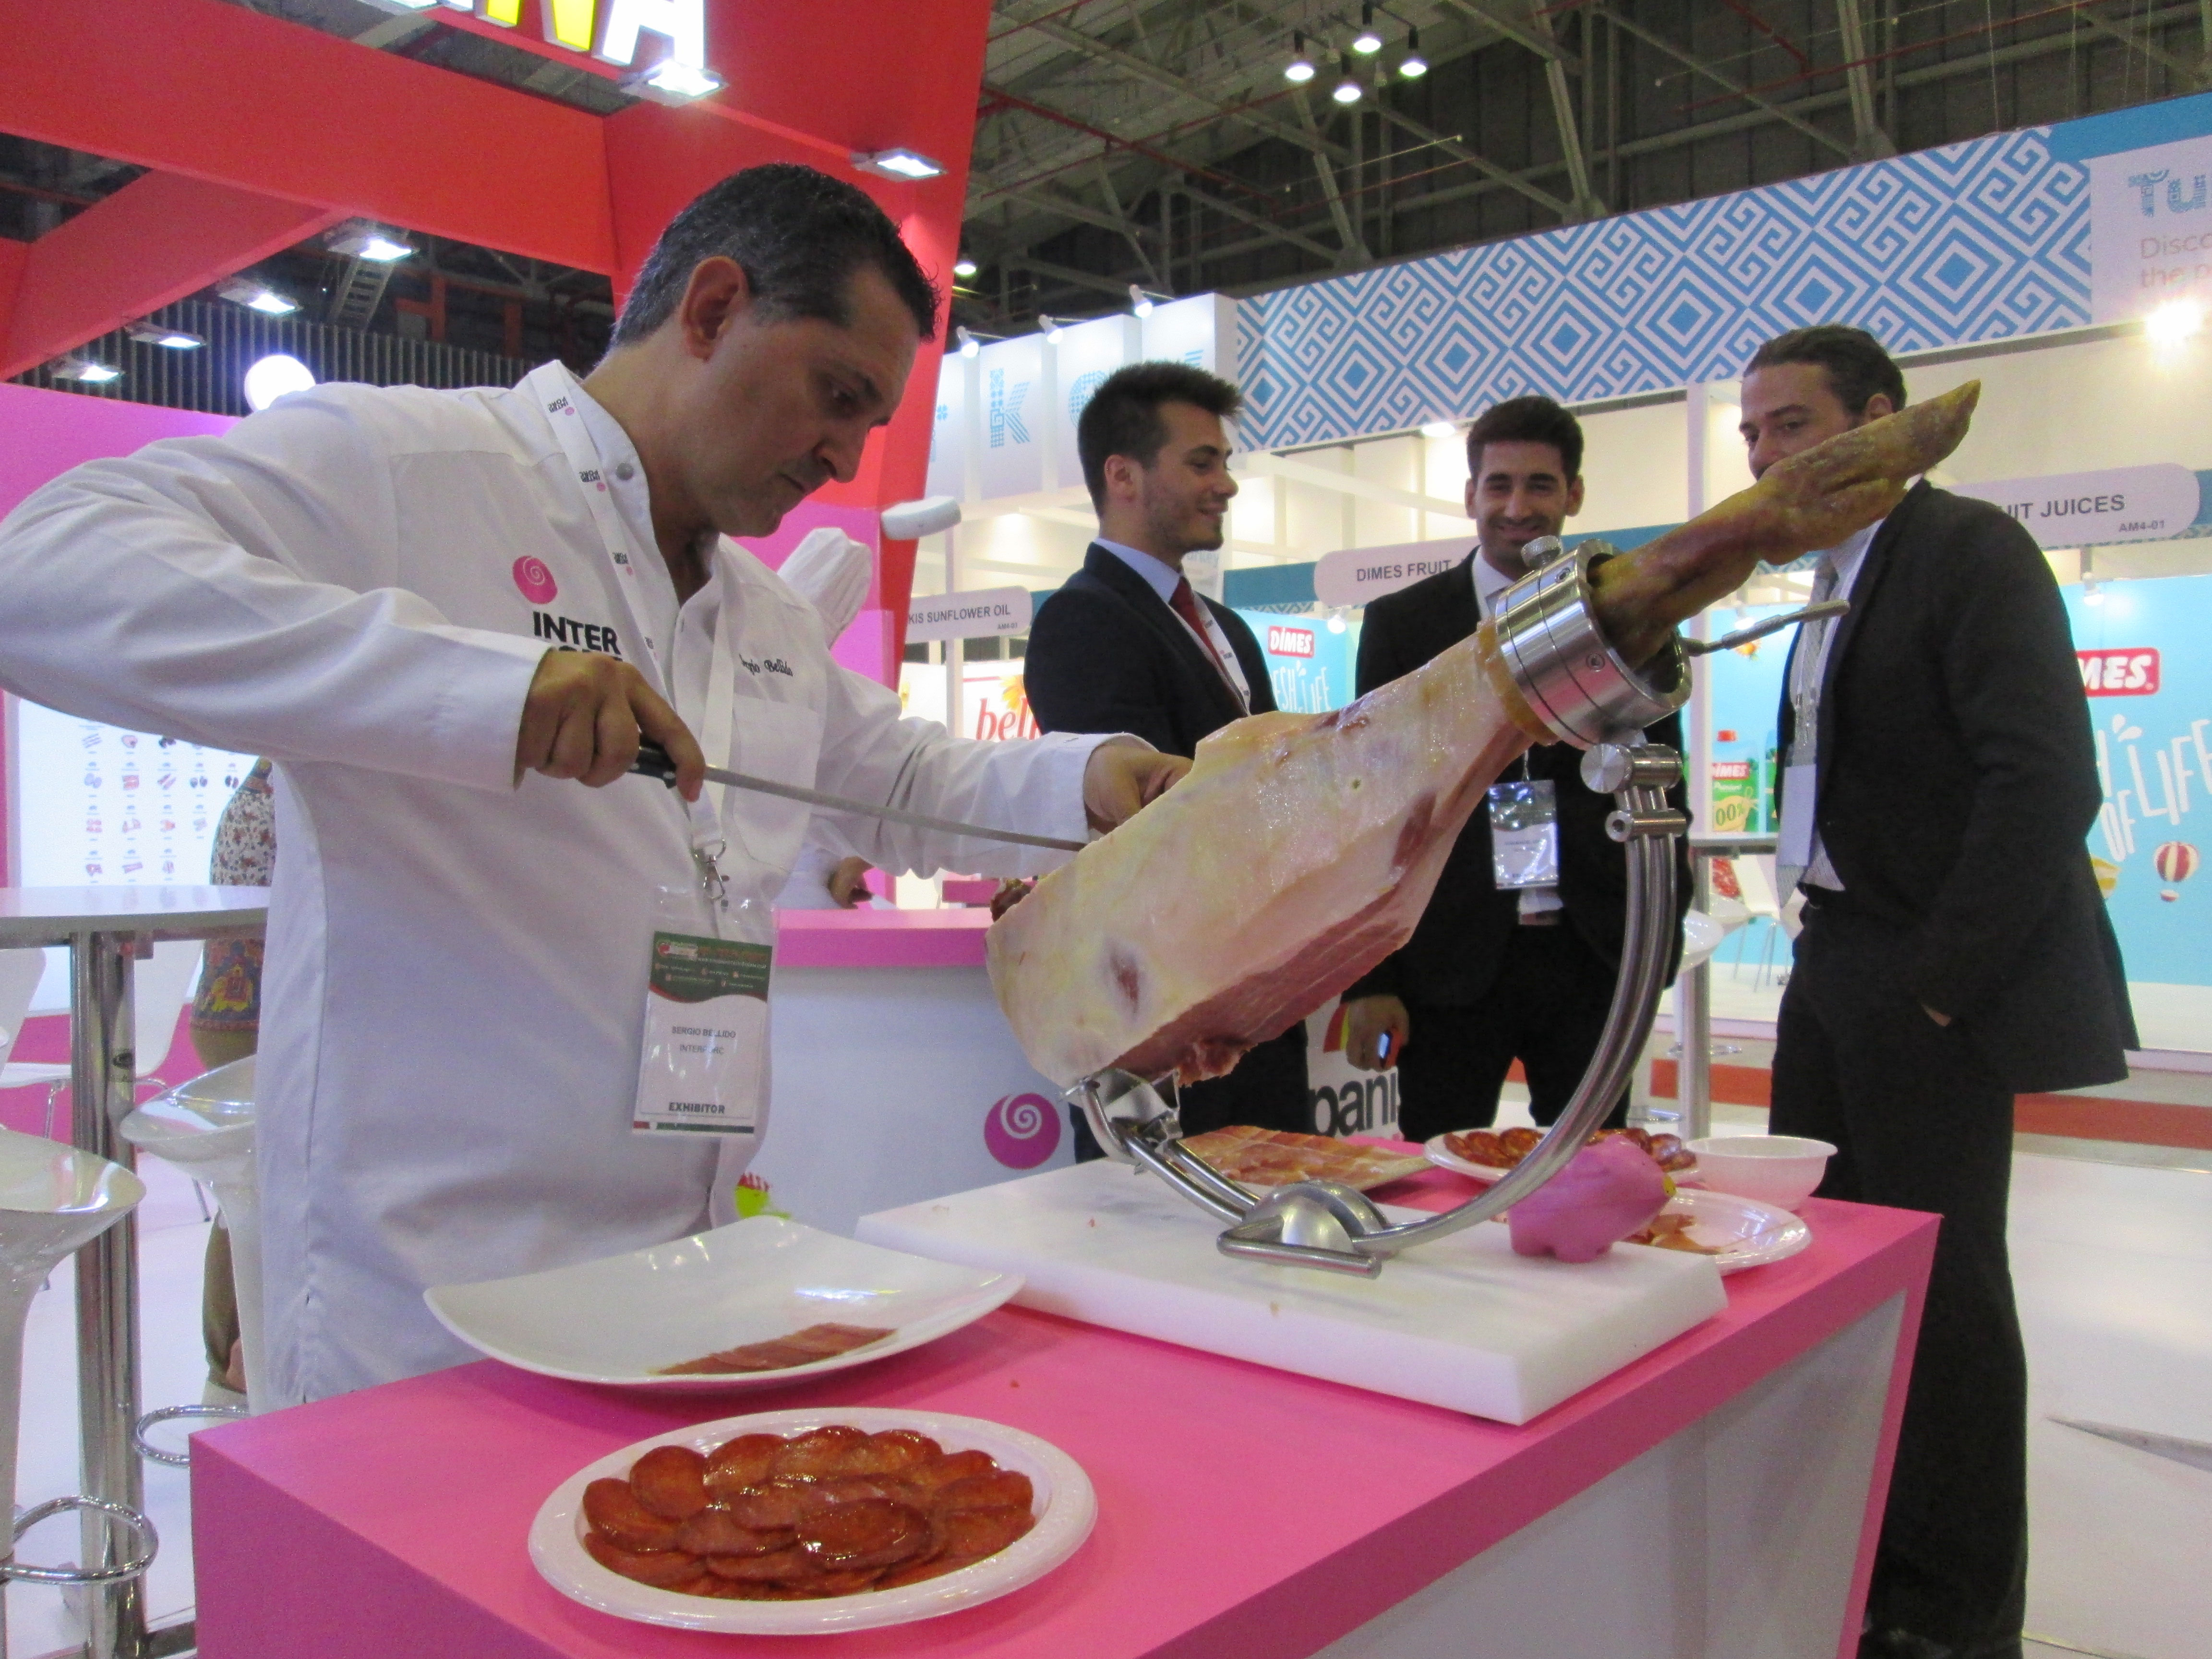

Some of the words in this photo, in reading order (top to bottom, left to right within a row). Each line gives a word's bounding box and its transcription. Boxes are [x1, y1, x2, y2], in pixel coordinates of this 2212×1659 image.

[2041, 494, 2127, 517] JUICES
[2118, 519, 2165, 532] AM4-01
[1357, 565, 1402, 581] DIMES
[1407, 560, 1452, 576] FRUIT
[927, 606, 991, 623] SUNFLOWER
[994, 604, 1010, 616] OIL
[533, 611, 622, 655] INTER
[2128, 719, 2212, 825] LIFE
[672, 1026, 701, 1035] SERGIO
[669, 1102, 725, 1114] EXHIBITOR
